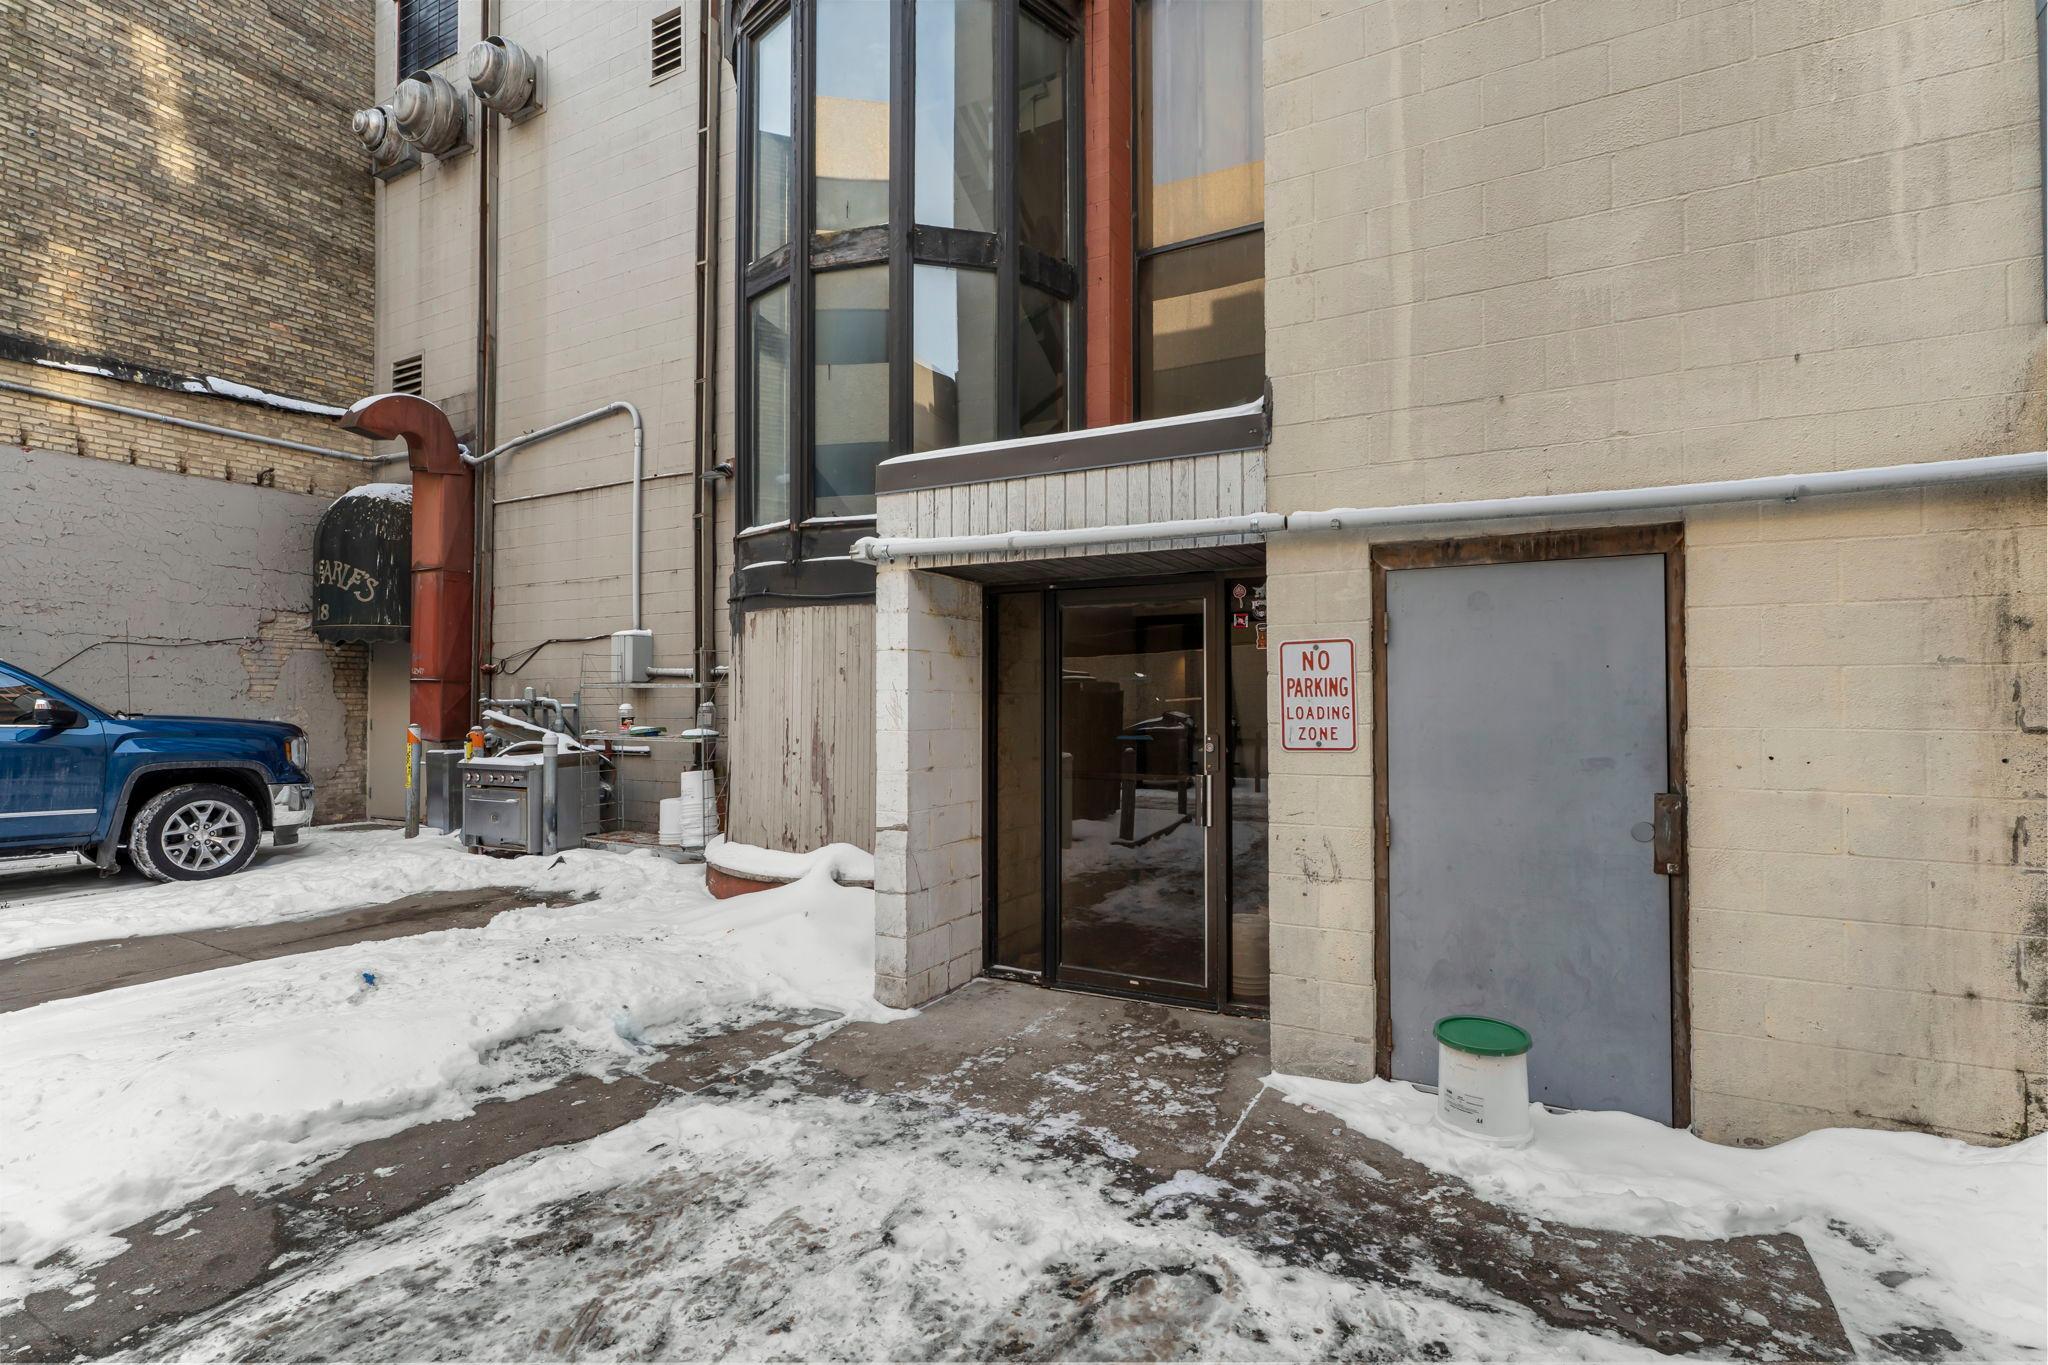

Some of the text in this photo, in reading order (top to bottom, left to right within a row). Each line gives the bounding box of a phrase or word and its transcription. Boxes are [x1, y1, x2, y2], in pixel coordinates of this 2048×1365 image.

[1302, 650, 1330, 671] NO
[1286, 677, 1349, 697] PARKING
[1286, 706, 1350, 720] LOADING
[1298, 727, 1338, 741] ZONE
